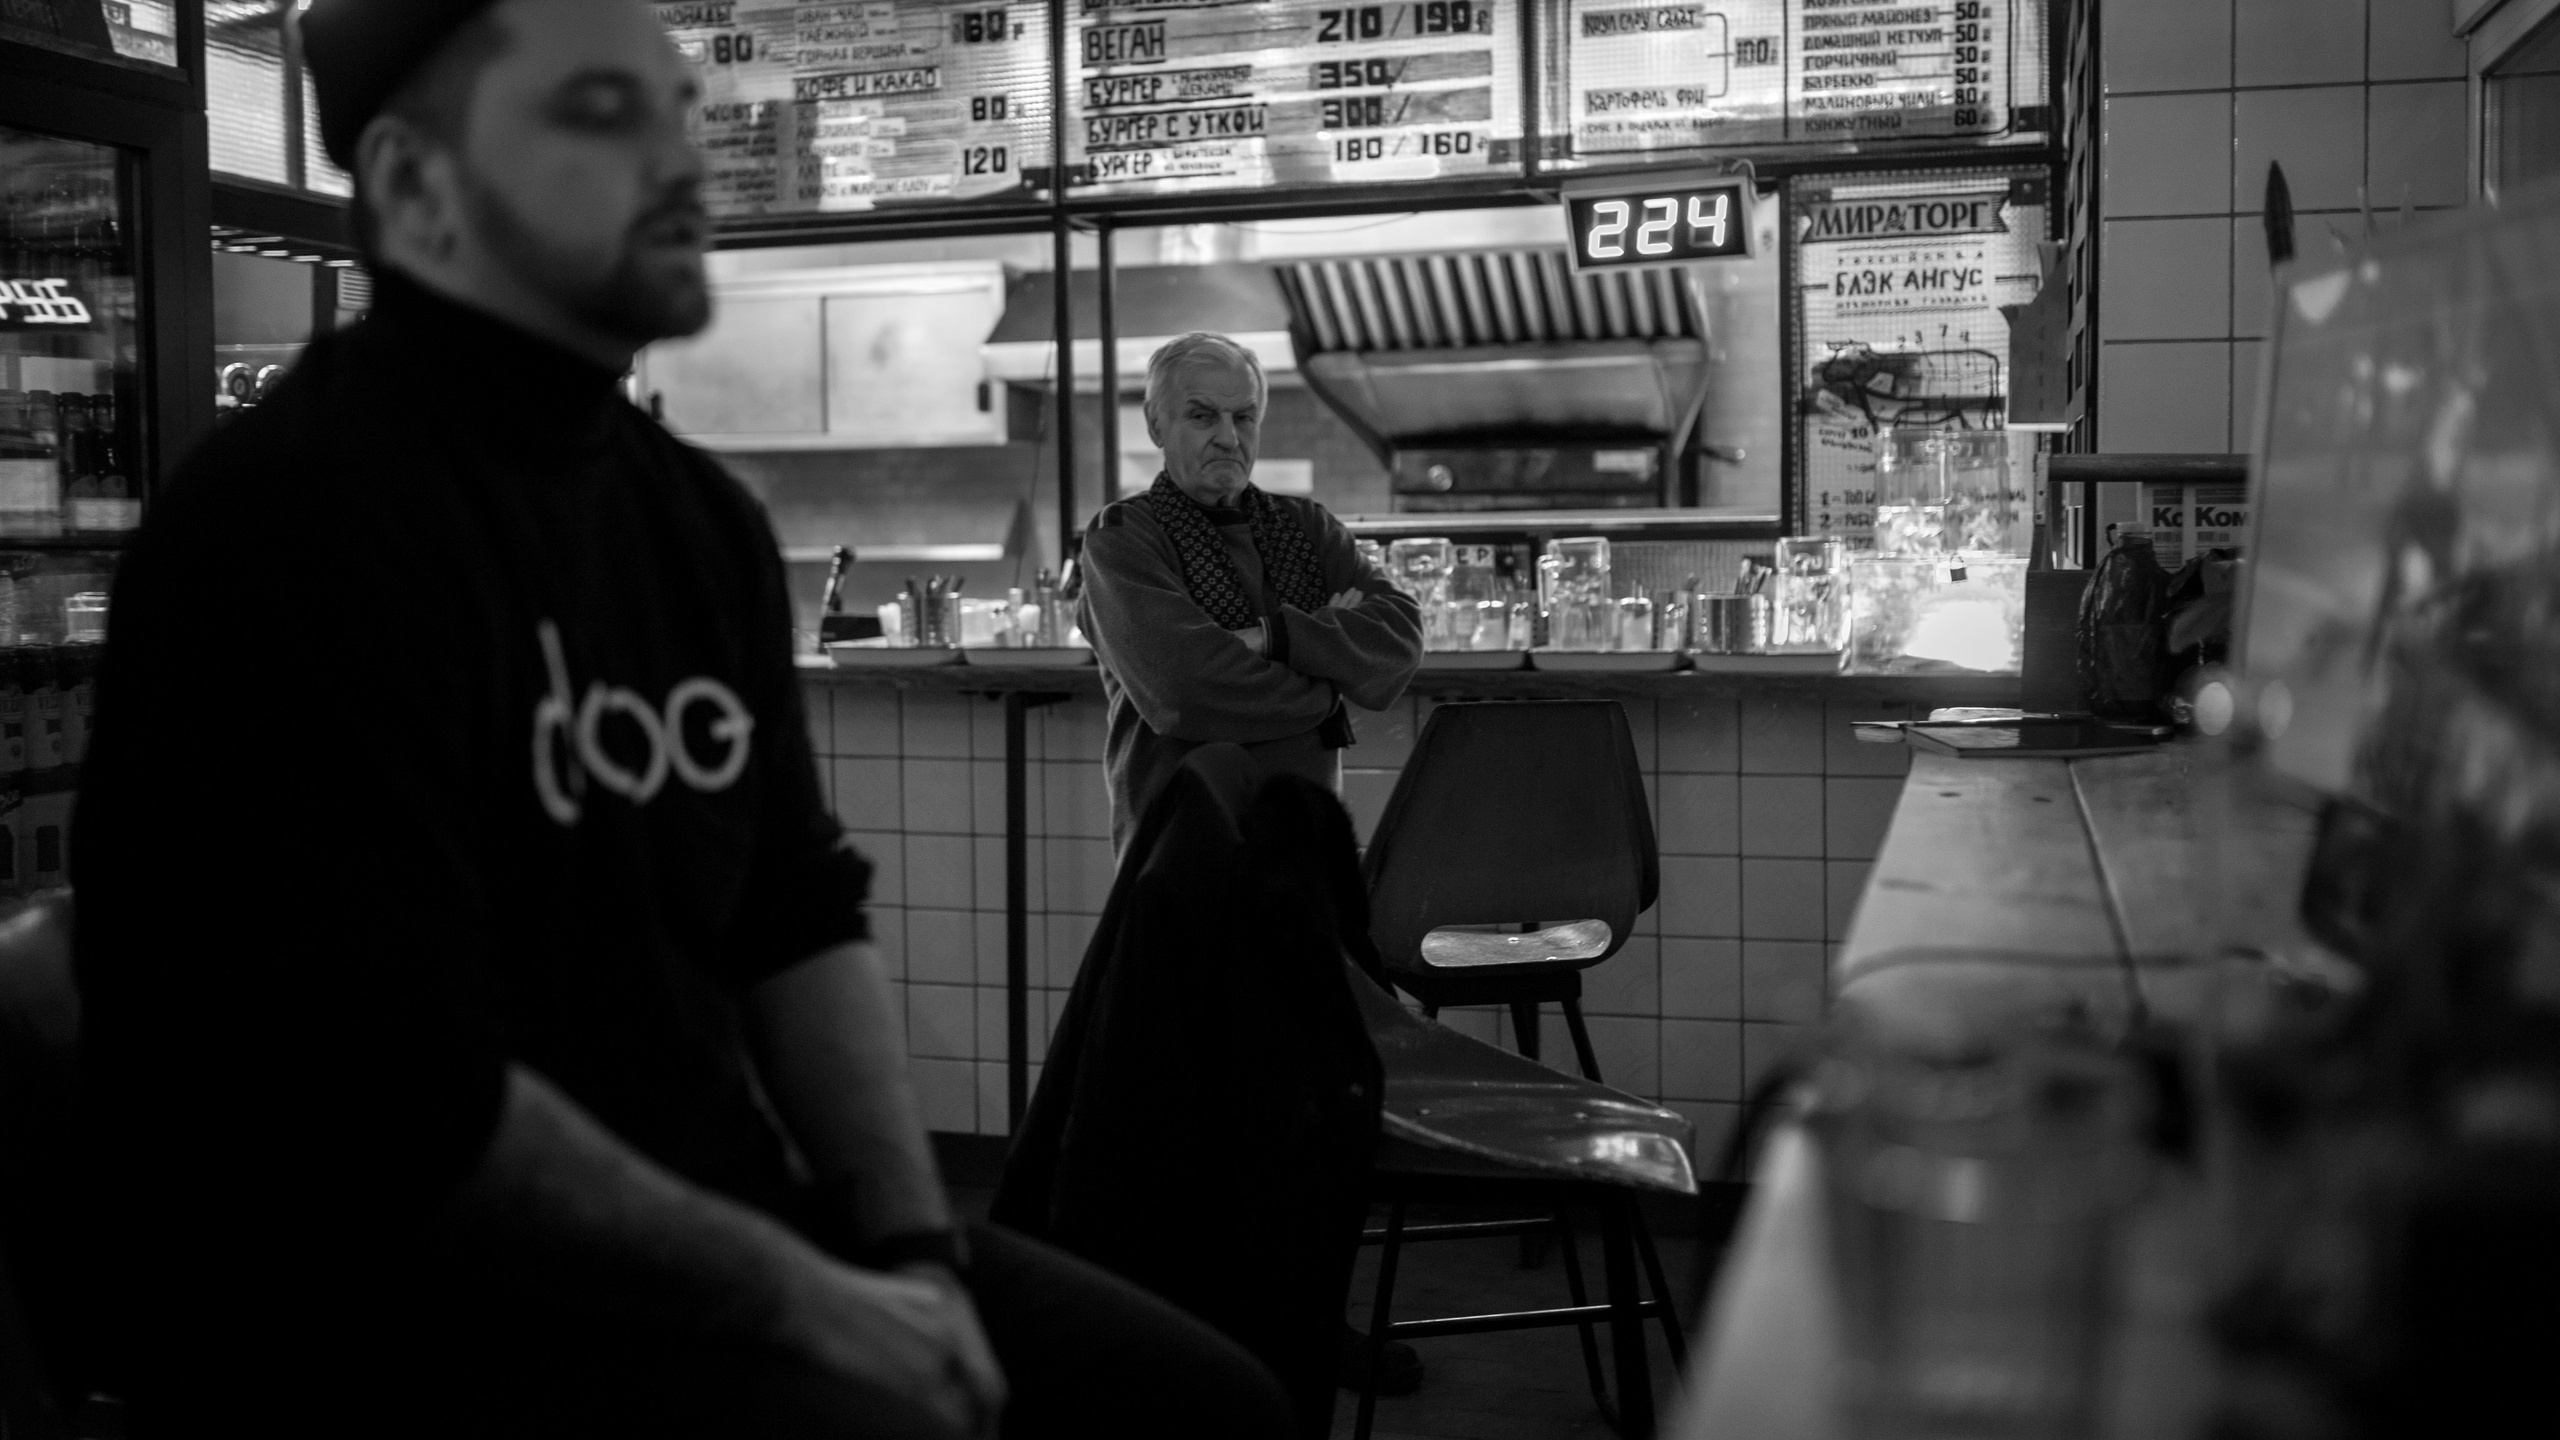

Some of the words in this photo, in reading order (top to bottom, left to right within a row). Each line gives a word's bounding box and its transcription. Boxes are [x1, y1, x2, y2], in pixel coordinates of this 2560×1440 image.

[1956, 2, 1979, 21] 50
[1087, 25, 1165, 62] ВЕГАН
[1318, 7, 1382, 43] 210
[1956, 23, 1978, 43] 50
[713, 34, 753, 64] 80
[1956, 46, 1978, 65] 50
[796, 76, 848, 101] КОФЕ
[855, 75, 866, 92] И
[874, 69, 937, 93] КАКАО
[1089, 77, 1162, 105] БУРГЕР
[1319, 59, 1387, 89] 350
[1956, 67, 1978, 85] 50
[972, 96, 1006, 121] 80
[1955, 87, 1978, 105] 80
[1088, 114, 1157, 143] БУРГЕР
[1167, 115, 1180, 138] С
[1323, 97, 1382, 128] 300
[1954, 108, 1978, 127] 60
[965, 147, 1006, 175] 120
[1088, 151, 1152, 179] БУРГЕР
[1336, 137, 1383, 162] 180
[1422, 132, 1472, 155] 160
[1587, 194, 1729, 259] 224
[1816, 201, 1989, 237] МИРАТОРГ
[1836, 270, 1893, 297] БЛЭК
[1903, 267, 1984, 292] АНГУС
